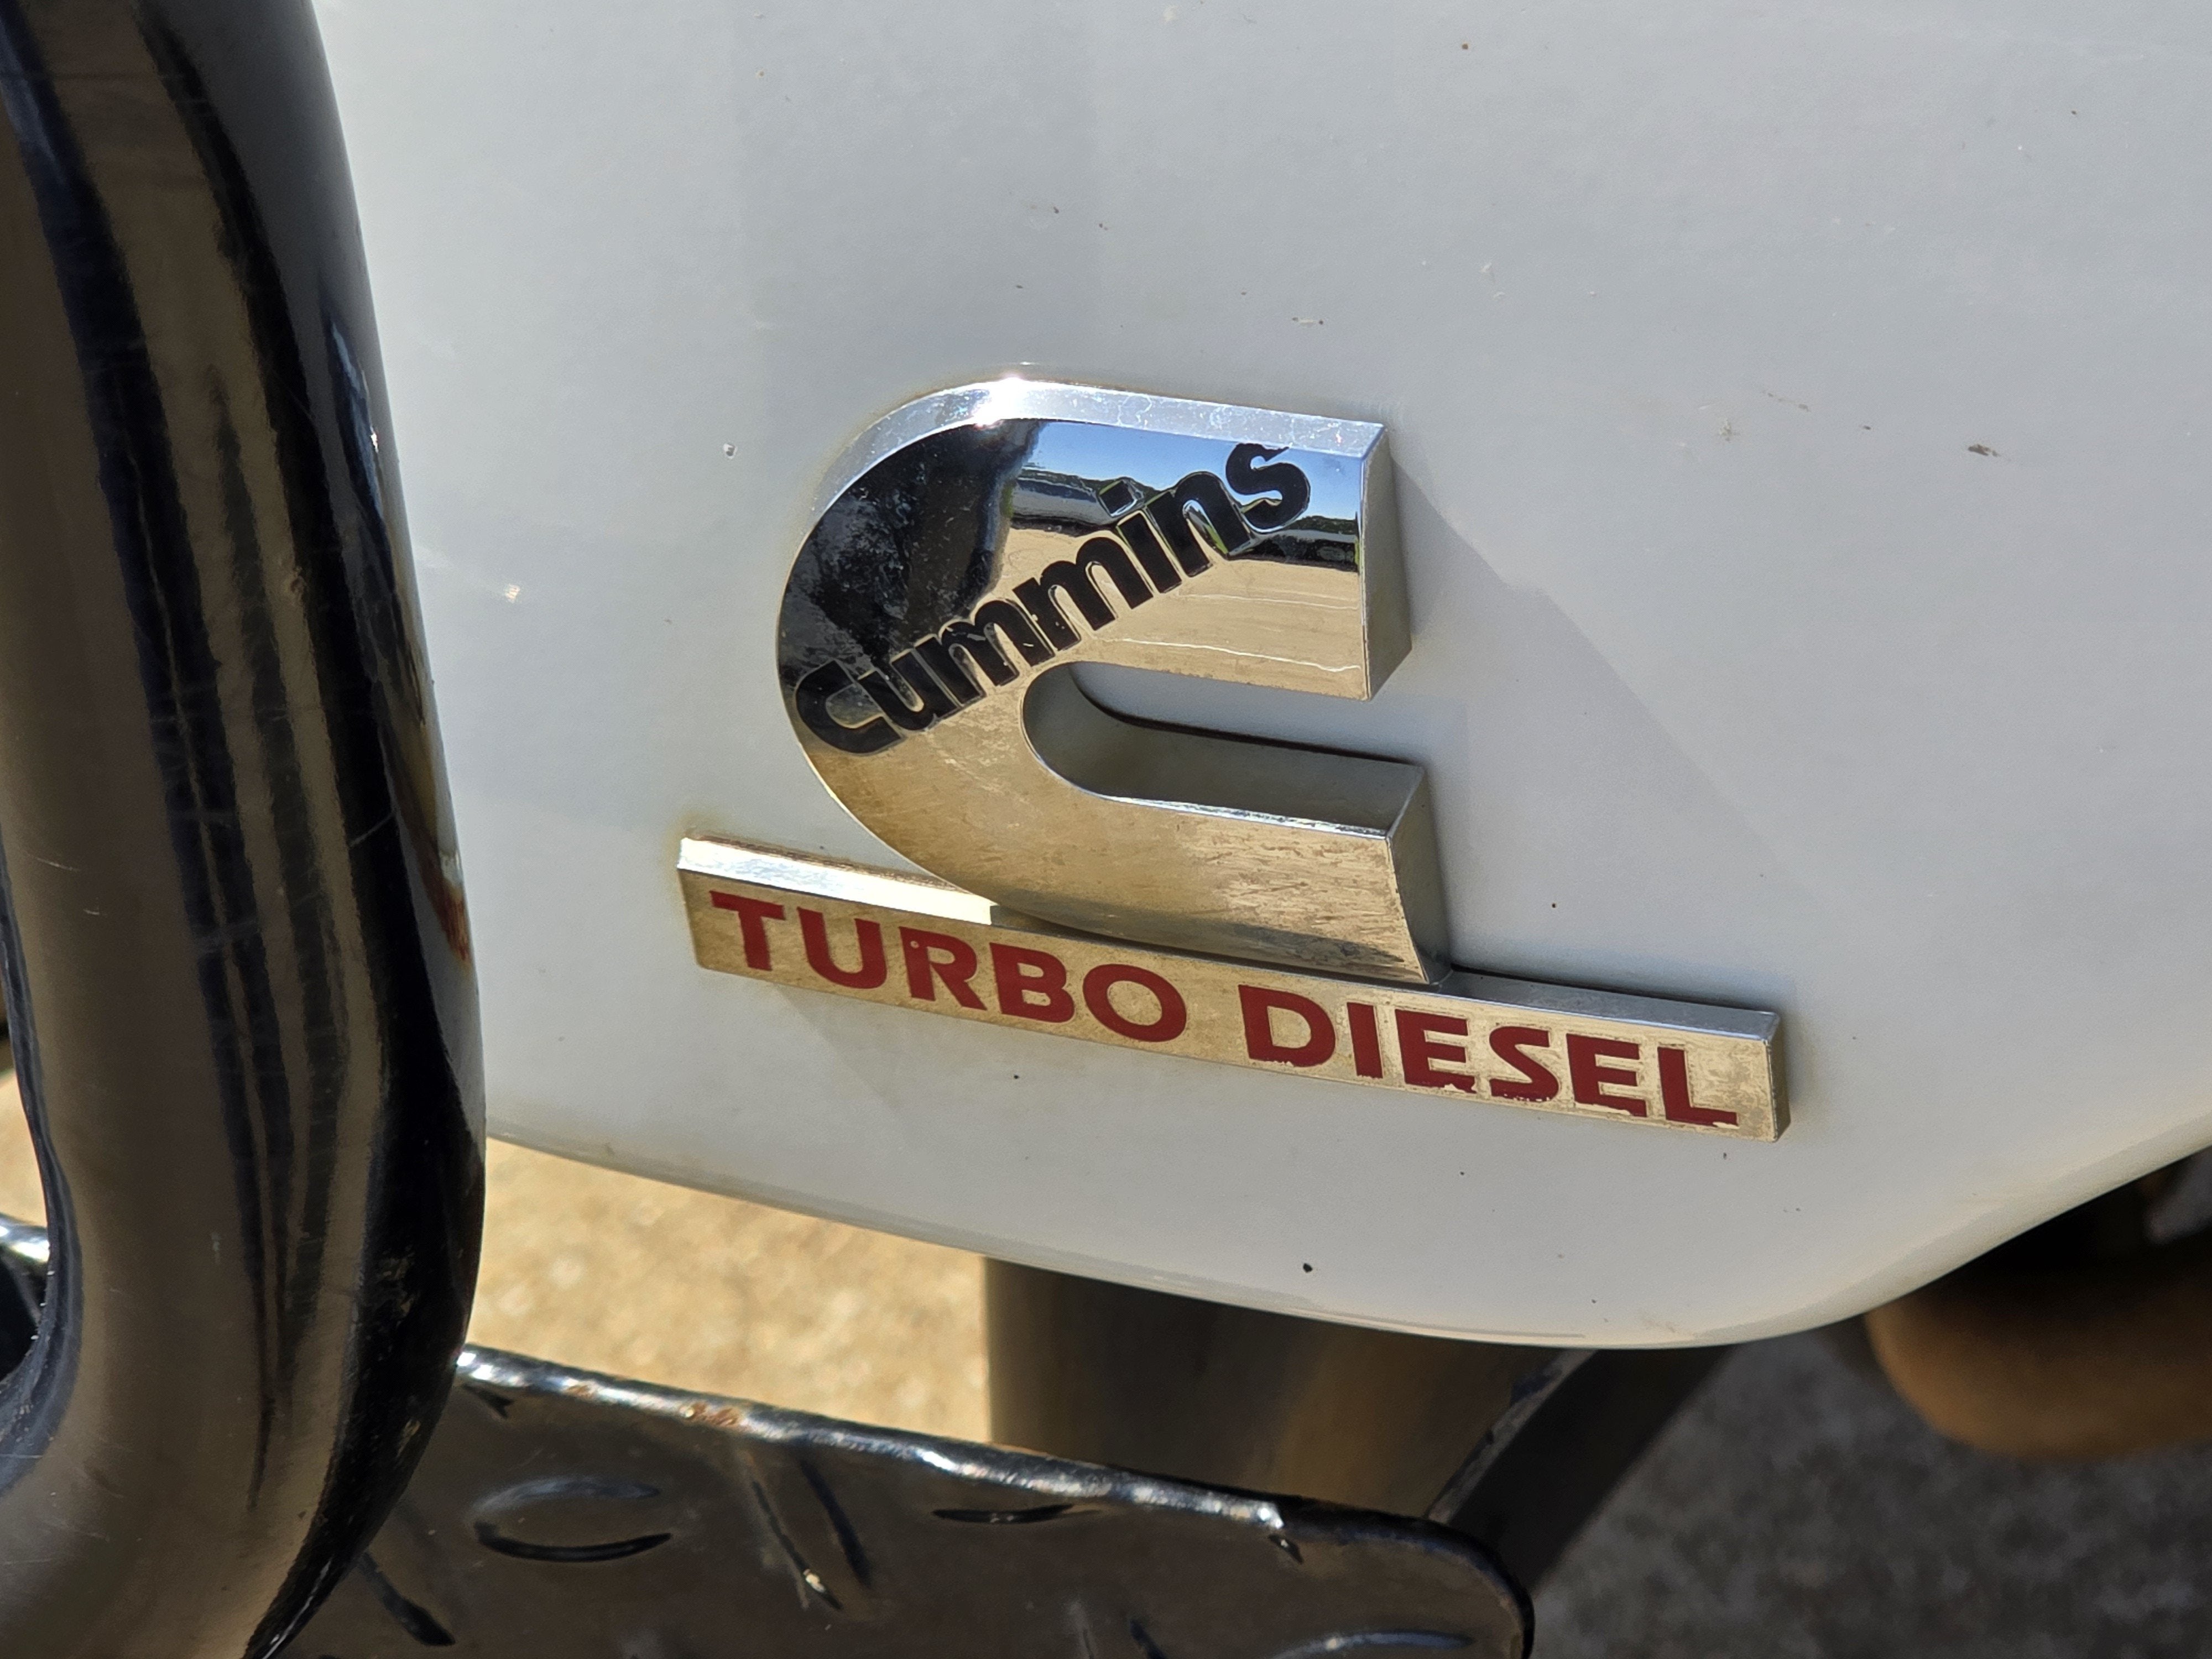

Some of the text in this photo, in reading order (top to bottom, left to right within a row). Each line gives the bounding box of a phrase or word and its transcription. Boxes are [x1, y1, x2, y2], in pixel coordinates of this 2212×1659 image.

[795, 442, 1311, 755] Cummins
[710, 890, 1739, 1126] TURBO DIESEL
